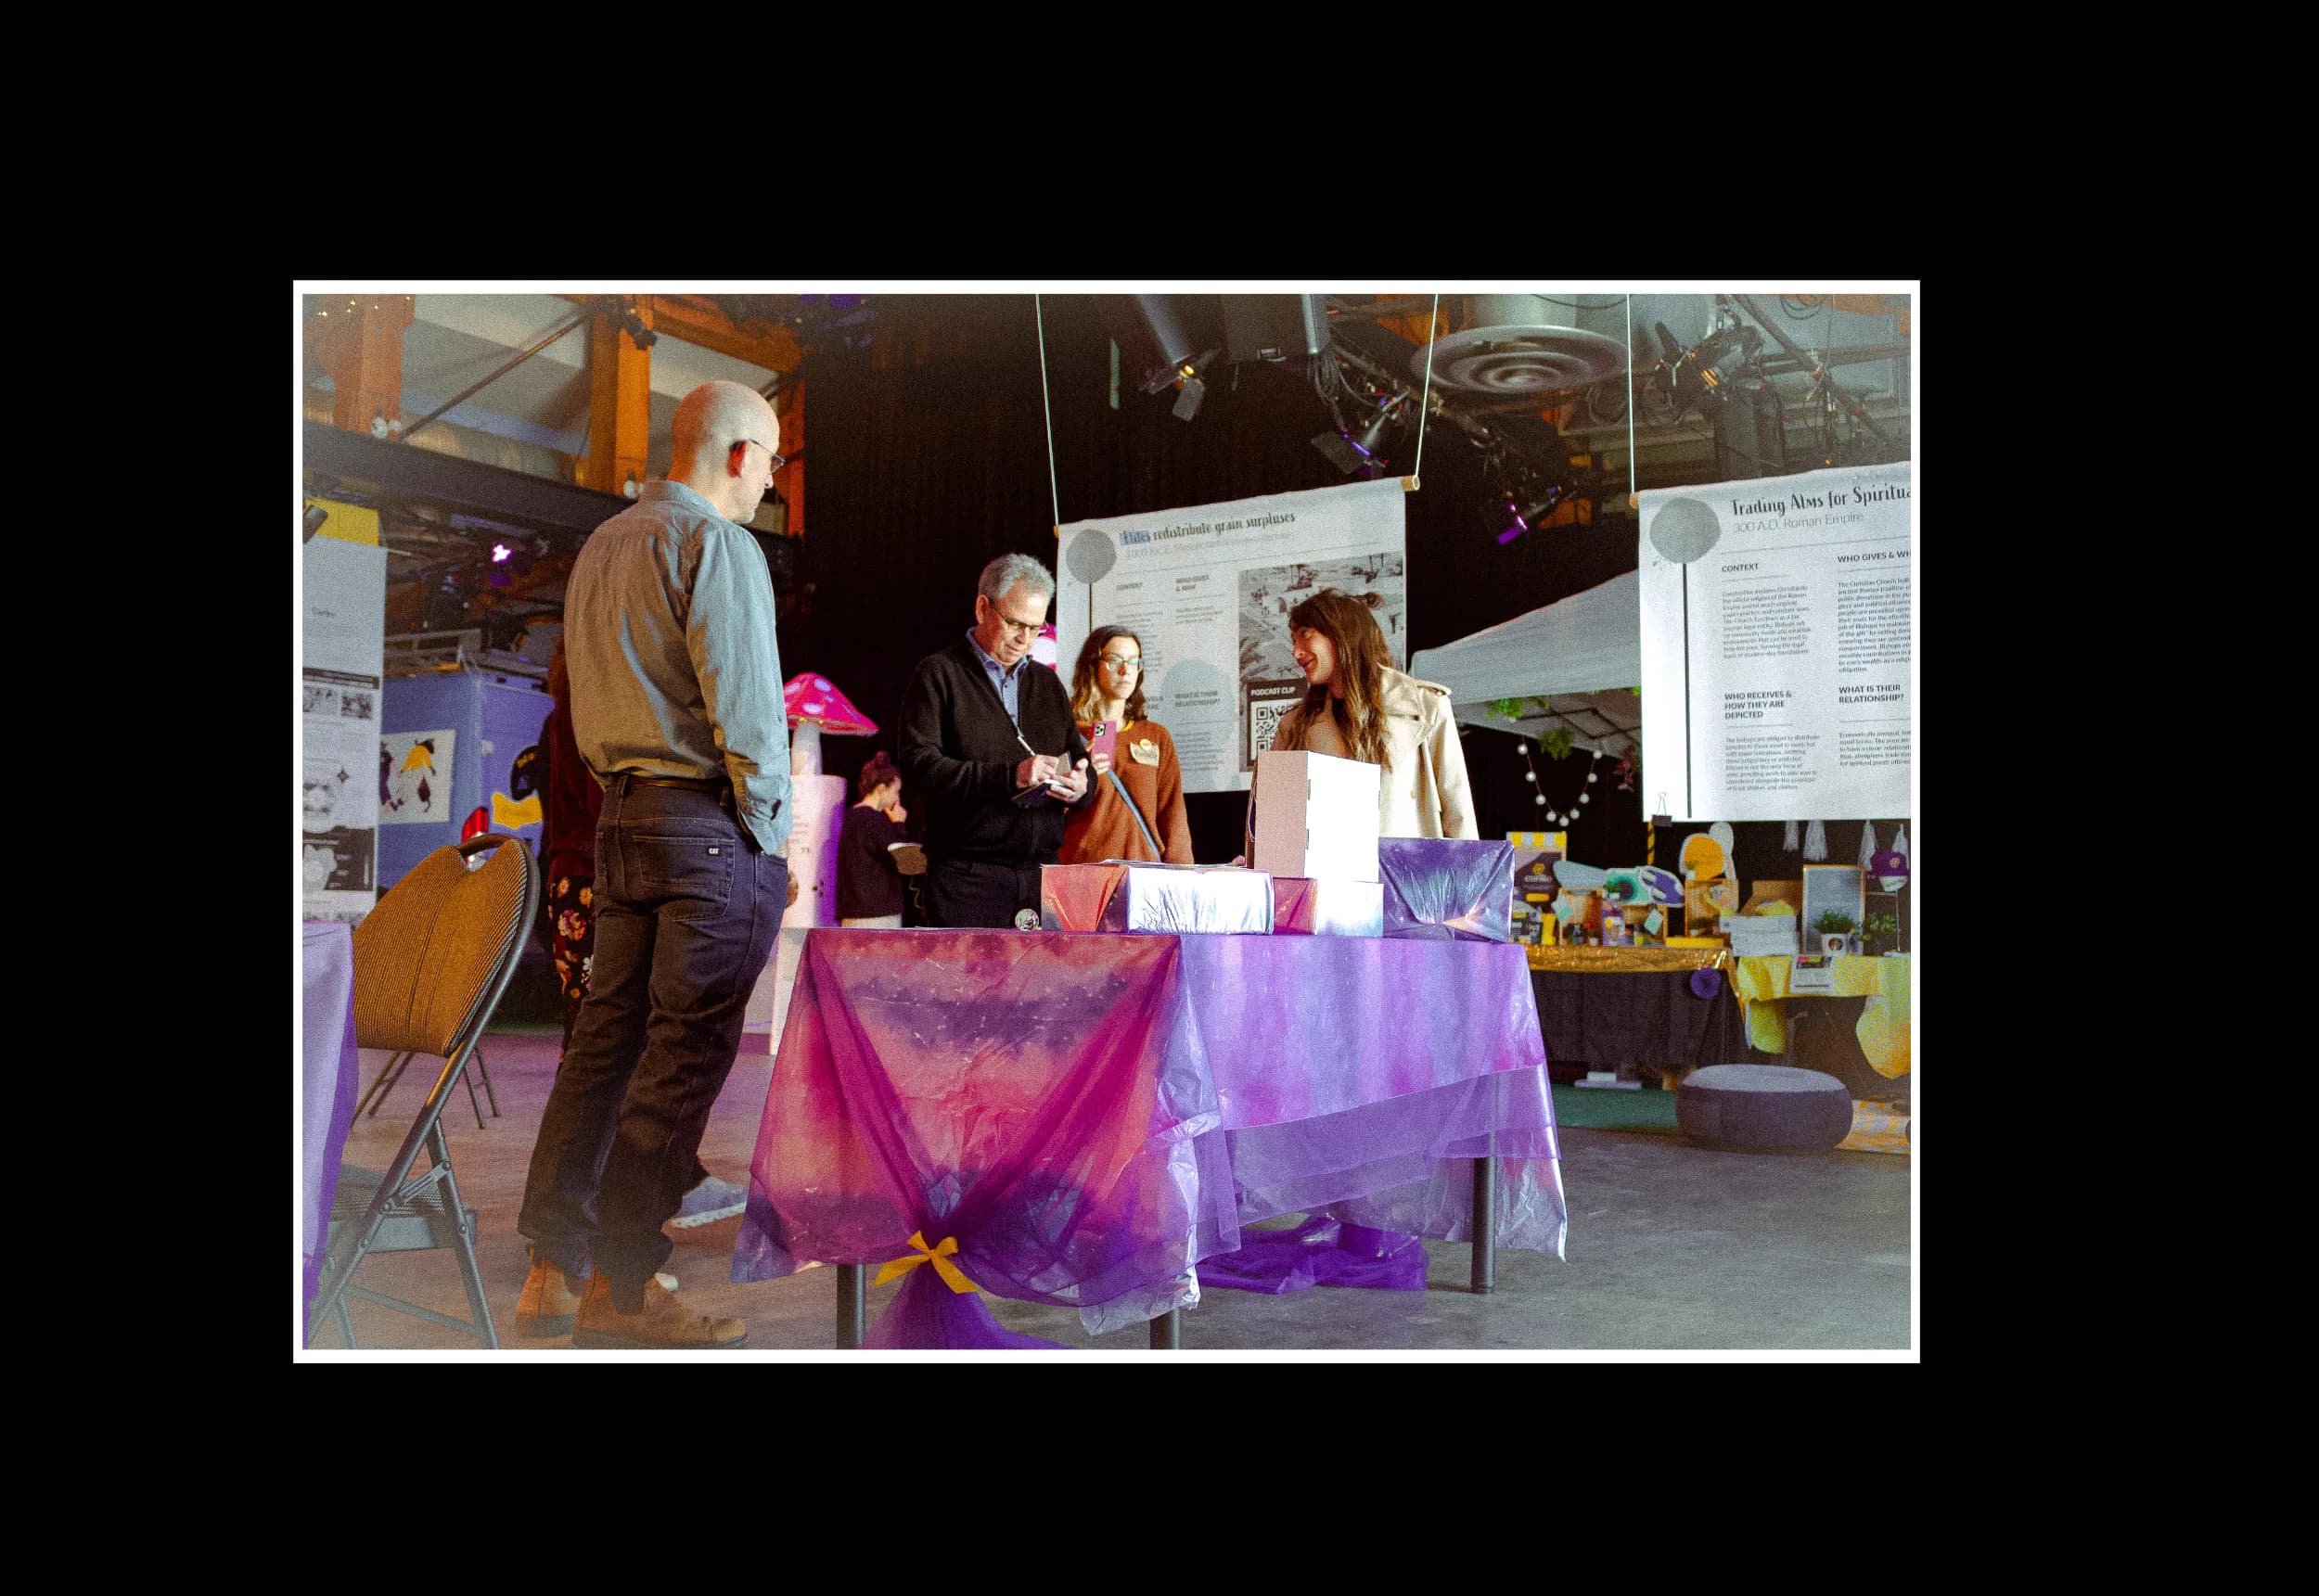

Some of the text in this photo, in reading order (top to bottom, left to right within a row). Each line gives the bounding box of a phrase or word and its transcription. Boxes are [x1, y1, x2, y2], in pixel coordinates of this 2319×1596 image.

[1732, 496, 1786, 517] Trading
[1827, 491, 1849, 508] for
[1153, 522, 1211, 541] redistribute
[1214, 518, 1243, 536] grain
[1245, 511, 1296, 530] surpluses
[1734, 521, 1755, 534] 300
[1784, 516, 1823, 530] Roman
[1825, 512, 1864, 526] Empire
[1838, 554, 1860, 563] WHO
[1862, 552, 1887, 562] GIVES
[1722, 562, 1759, 573] CONTEXT
[1250, 688, 1281, 696] PODCAST
[1839, 683, 1901, 694] WHAT IS THEIR
[1723, 690, 1792, 700] WHO RECEIVES &
[1839, 693, 1904, 704] RELATIONSHIP?
[1724, 700, 1786, 709] HOW THEY ARE
[1724, 710, 1763, 720] DEPICTED
